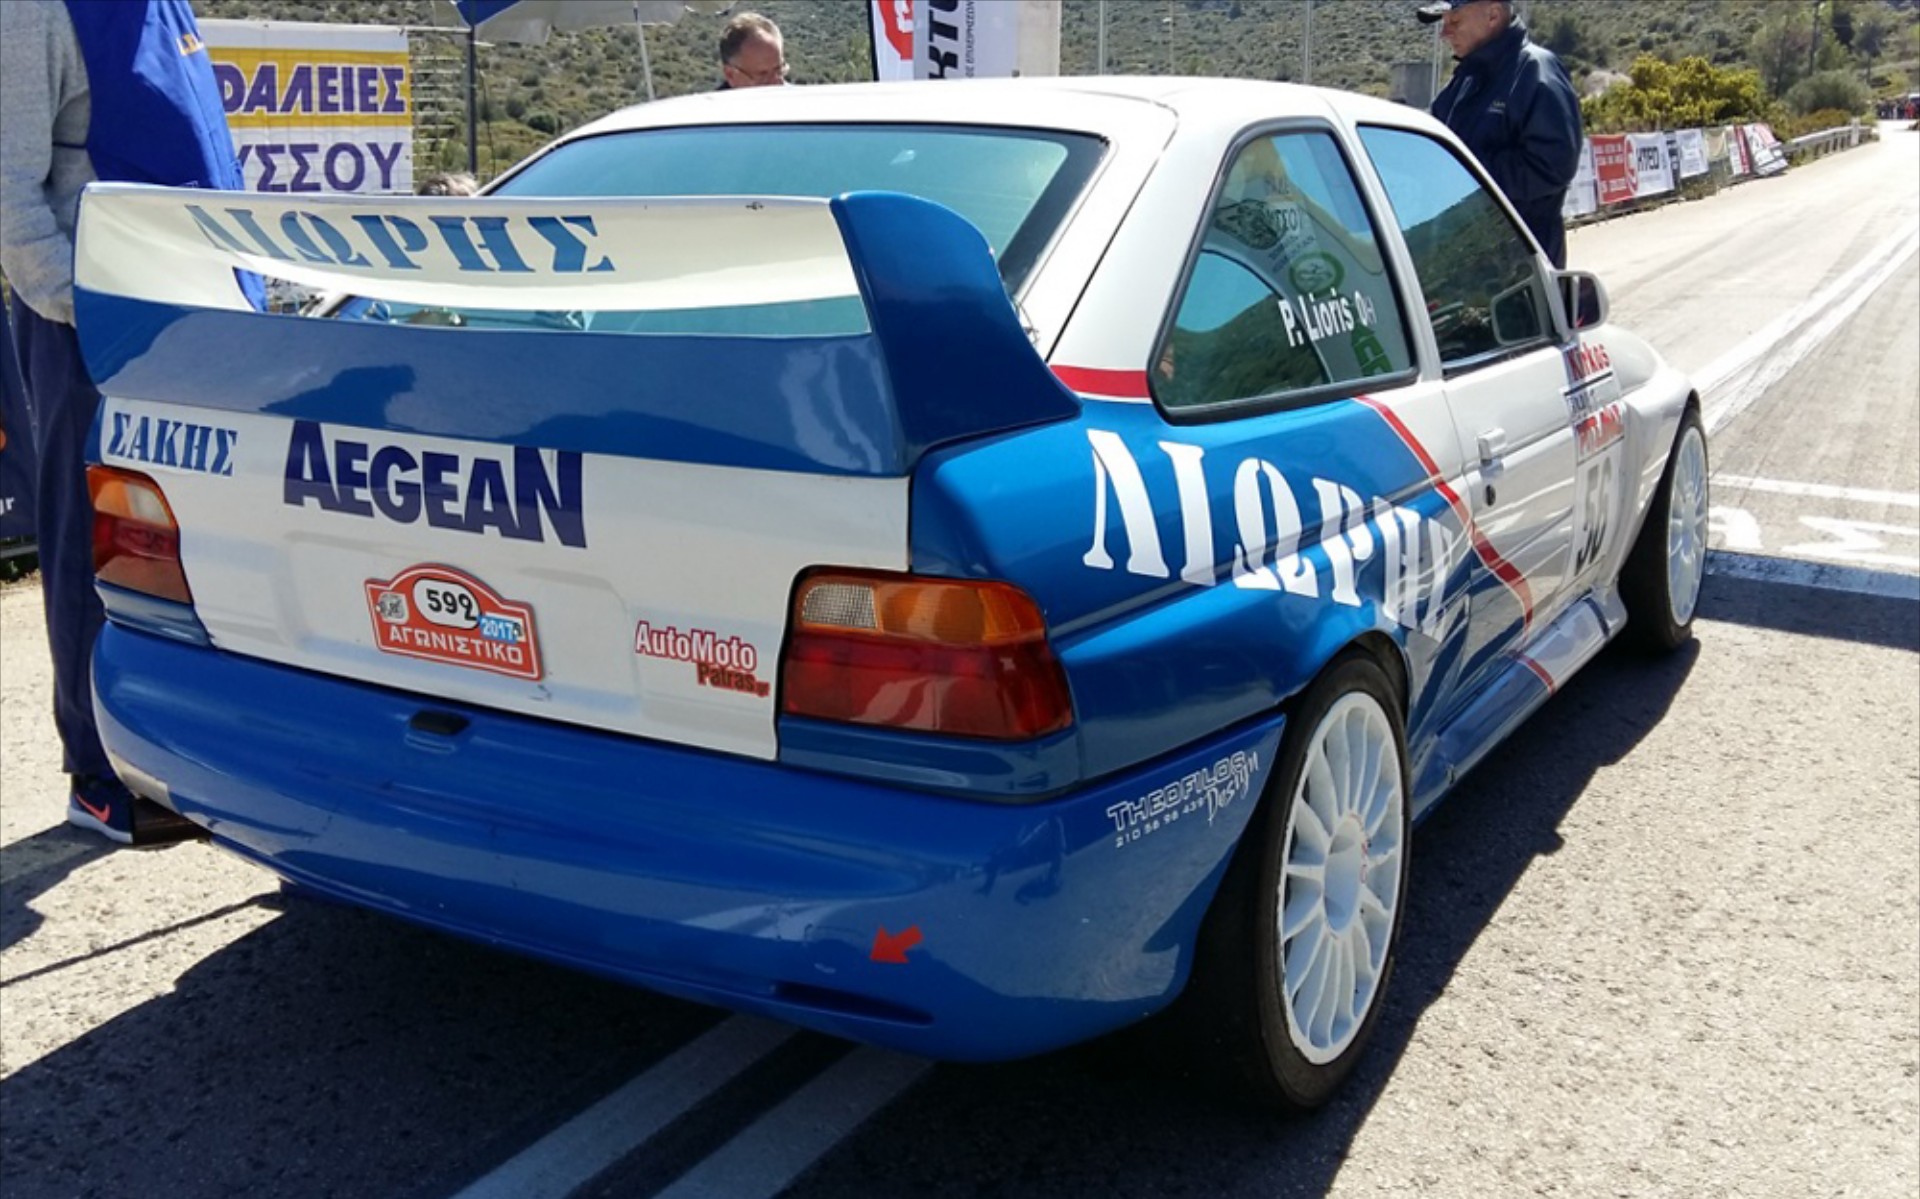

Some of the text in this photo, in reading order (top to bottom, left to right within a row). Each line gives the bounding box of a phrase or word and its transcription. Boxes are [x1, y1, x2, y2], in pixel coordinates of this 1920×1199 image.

[184, 204, 615, 273] ΛΙΩΡΗΣ
[1297, 287, 1354, 341] Lioris
[107, 411, 238, 477] ΣΑΚΗΣ
[284, 420, 587, 548] AEGEAN
[426, 588, 478, 621] 592
[389, 625, 523, 665] ΑΓΩΝΙΣΤΙΚΟ
[635, 620, 757, 671] AutoMoto
[1106, 751, 1247, 832] THEOFILOS
